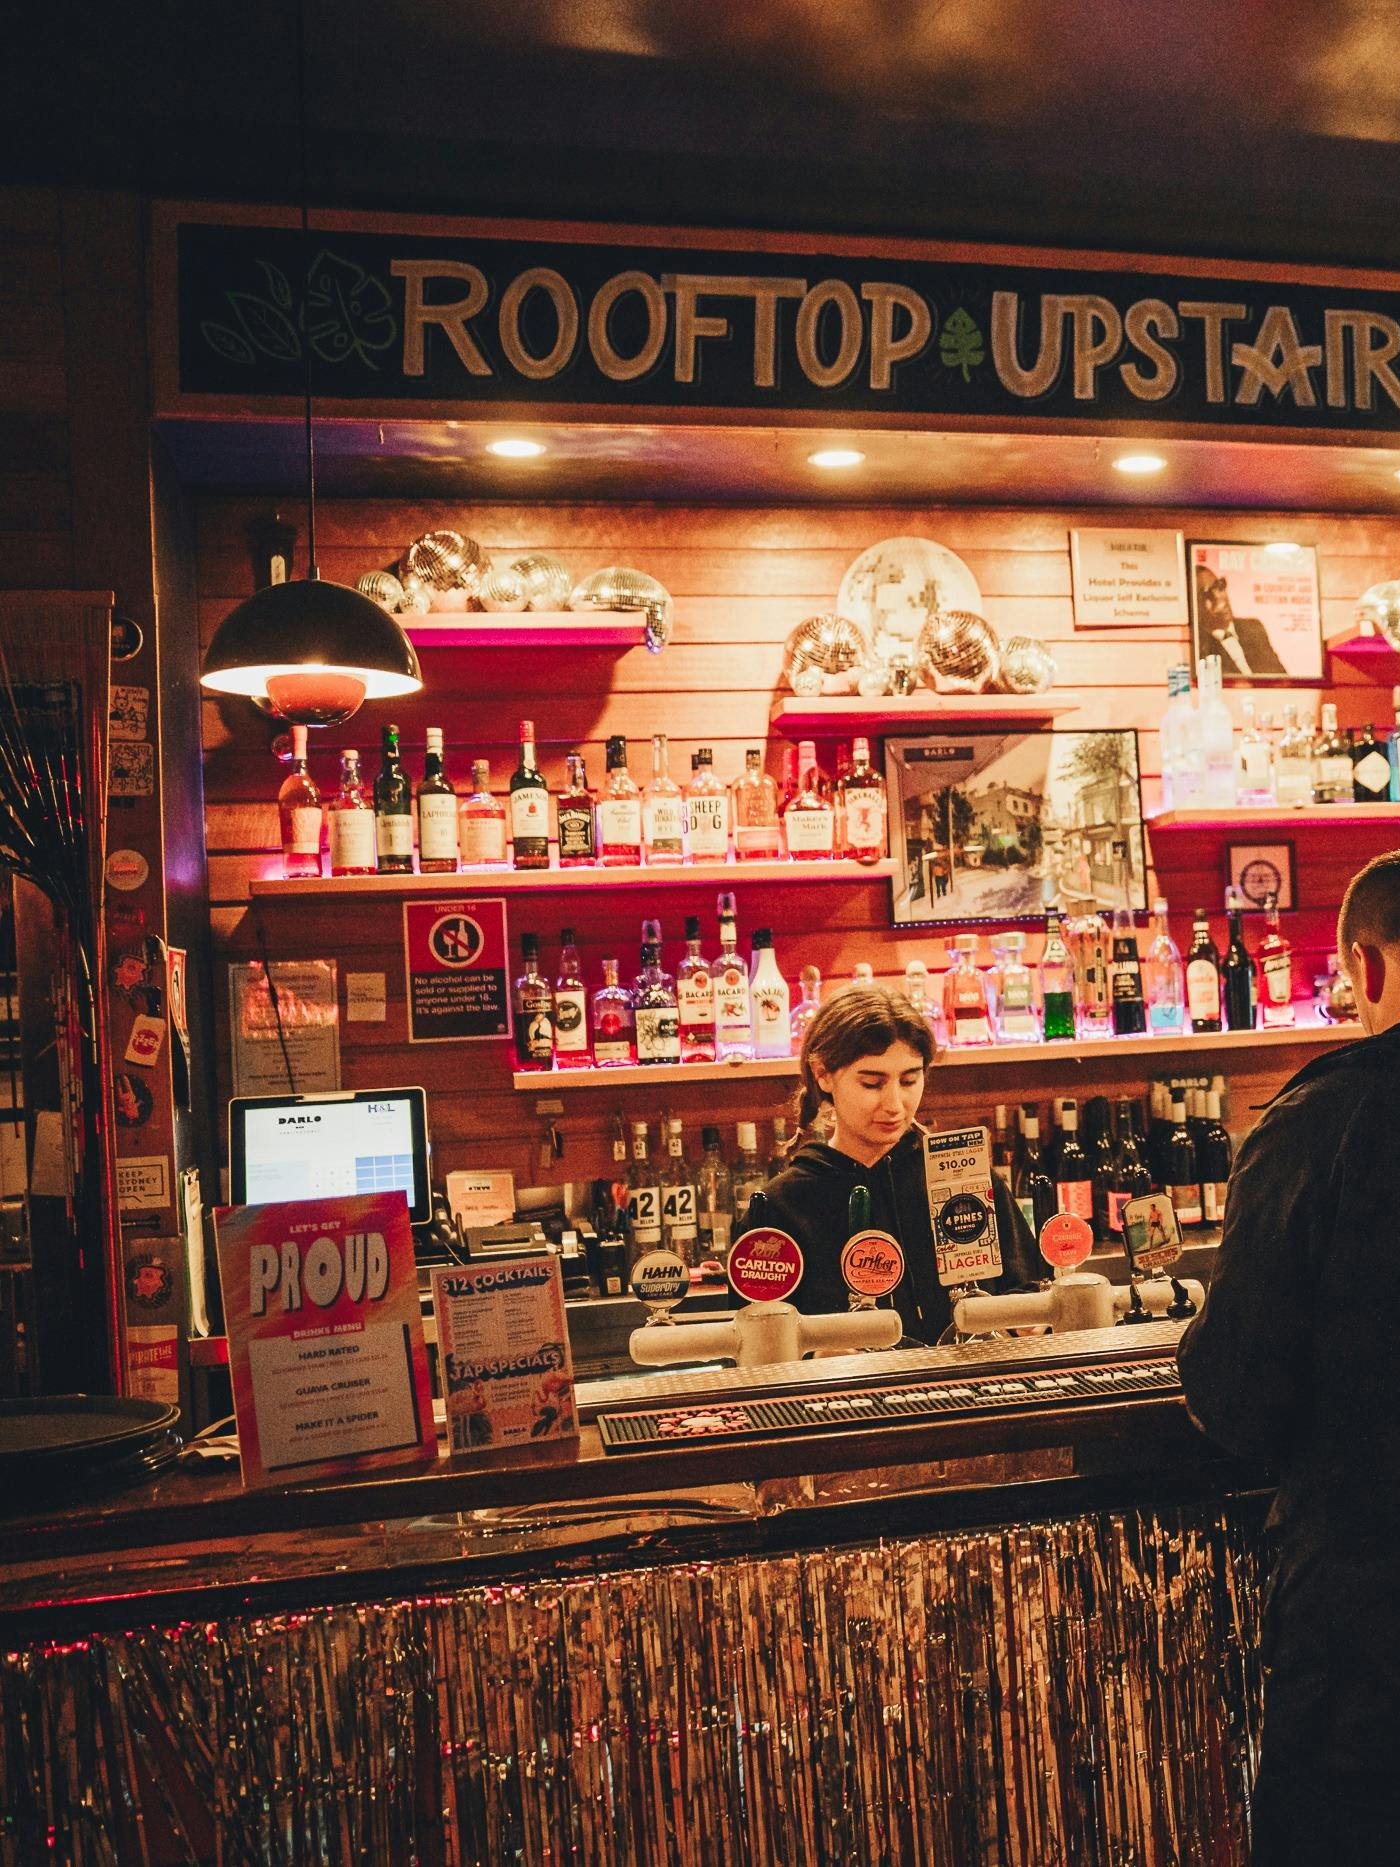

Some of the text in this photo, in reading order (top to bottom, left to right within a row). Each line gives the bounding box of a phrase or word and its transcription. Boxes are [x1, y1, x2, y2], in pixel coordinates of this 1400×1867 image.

[390, 259, 932, 390] ROOFTOP
[1088, 578, 1116, 587] Hotel
[1119, 578, 1161, 588] Provides
[690, 800, 721, 814] SHEEP
[434, 904, 465, 914] UNDER
[414, 973, 495, 986] No alcohol can be
[415, 983, 498, 996] sold or supplied to
[415, 993, 493, 1006] anyone under 18.
[416, 1001, 499, 1016] It's against the law.
[278, 1115, 322, 1125] DARLO
[929, 1132, 981, 1146] NOW ON TAP
[938, 1157, 976, 1172] $10.00
[118, 1170, 144, 1178] KEEP
[118, 1176, 158, 1186] SYDNEY
[118, 1185, 146, 1194] OPEN
[663, 1189, 692, 1217] 42
[945, 1211, 984, 1226] 4 PINES
[289, 1221, 341, 1234] LET'S GET
[954, 1223, 976, 1232] BREWING
[735, 1257, 796, 1274] CARLTON
[849, 1249, 898, 1272] Grifter
[949, 1254, 990, 1270] LAGER
[250, 1232, 391, 1318] PROUD
[642, 1265, 683, 1280] HAHN
[740, 1270, 788, 1283] DRAUGHT
[442, 1276, 469, 1292] $12
[293, 1321, 362, 1339] DRINKS MENU
[298, 1344, 360, 1361] HARD RATED
[449, 1364, 485, 1380] TAP
[295, 1377, 371, 1397] GUAVA CRUISER
[804, 1398, 873, 1412] TOO
[884, 1387, 974, 1405] GOOD
[980, 1382, 1028, 1395] TO
[1034, 1376, 1079, 1390] BE
[295, 1410, 380, 1432] MAKE IT A SPIDER
